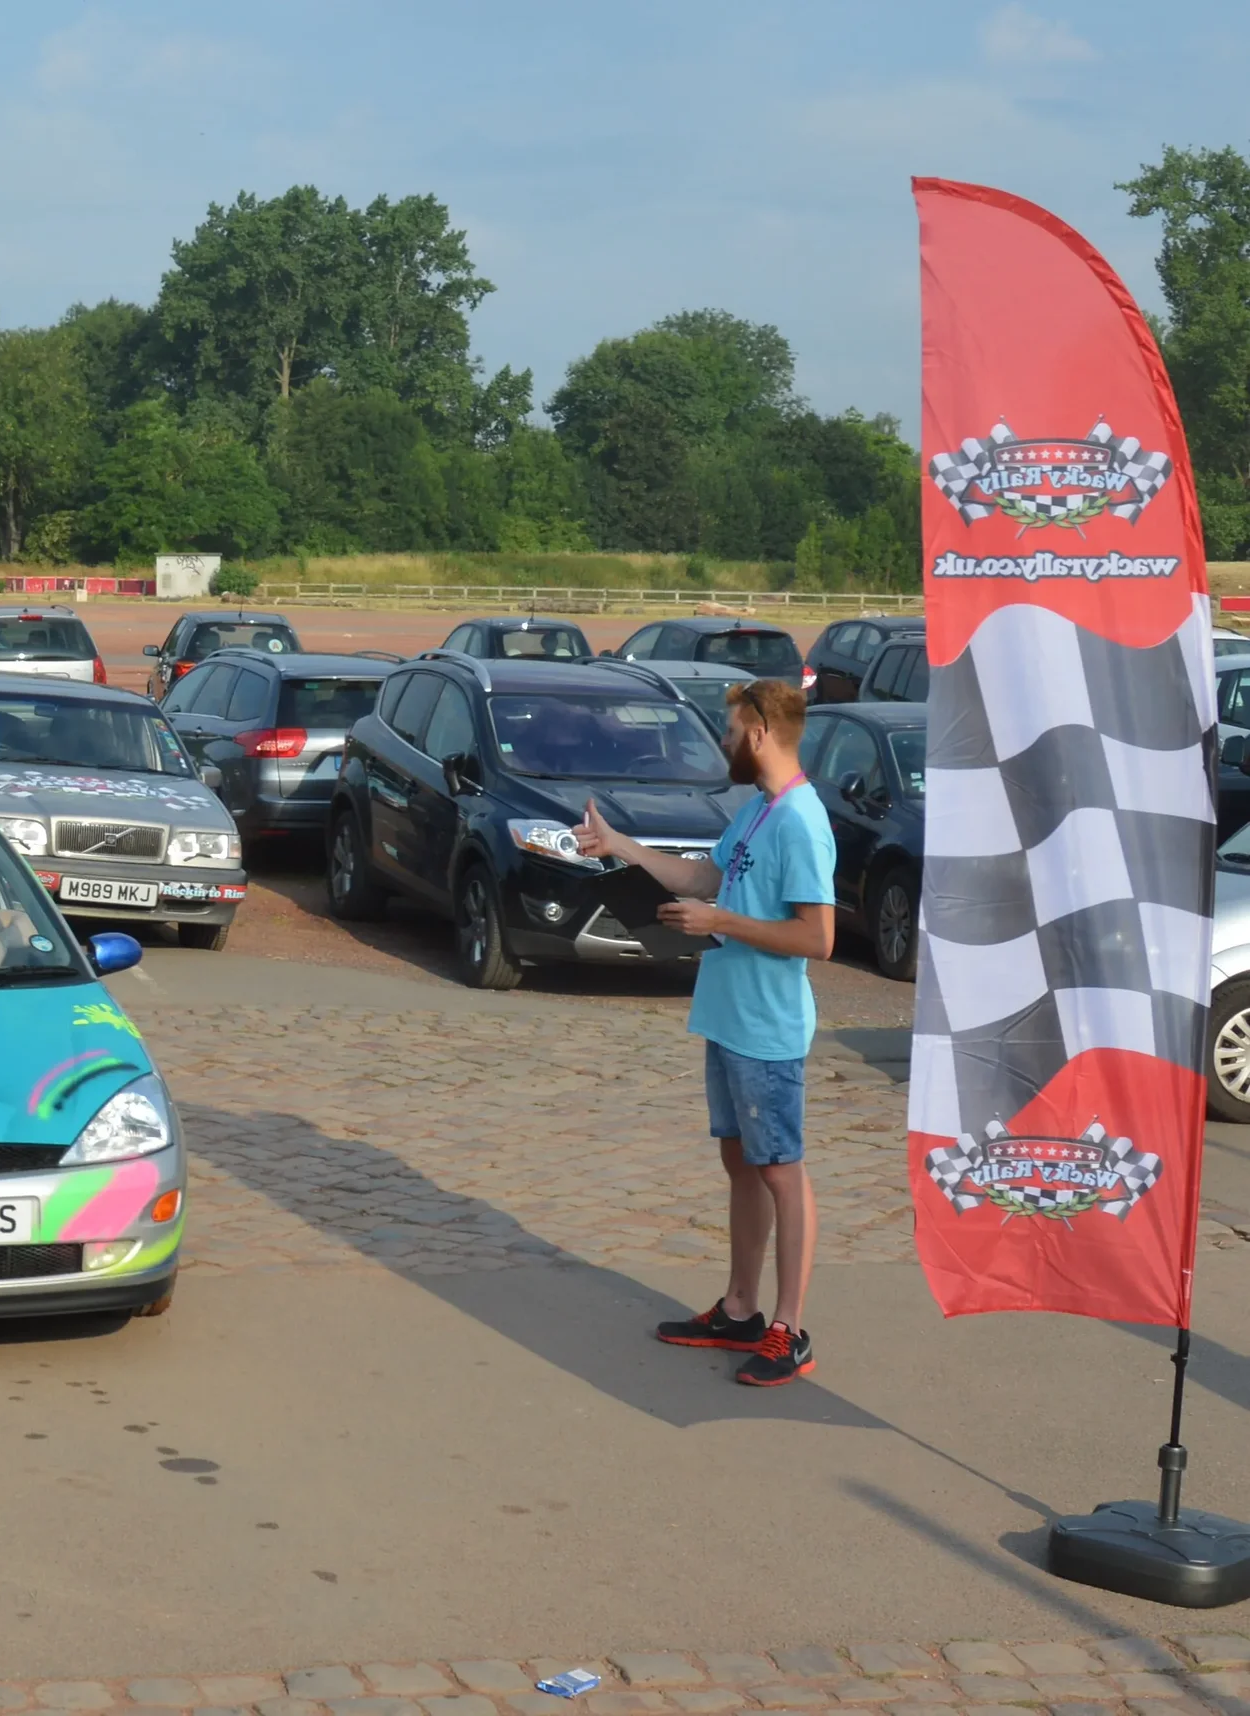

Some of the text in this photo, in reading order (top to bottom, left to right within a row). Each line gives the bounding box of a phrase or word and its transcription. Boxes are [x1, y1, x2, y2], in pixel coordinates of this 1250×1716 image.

[68, 882, 151, 902] M989 MKJ
[209, 888, 221, 898] to
